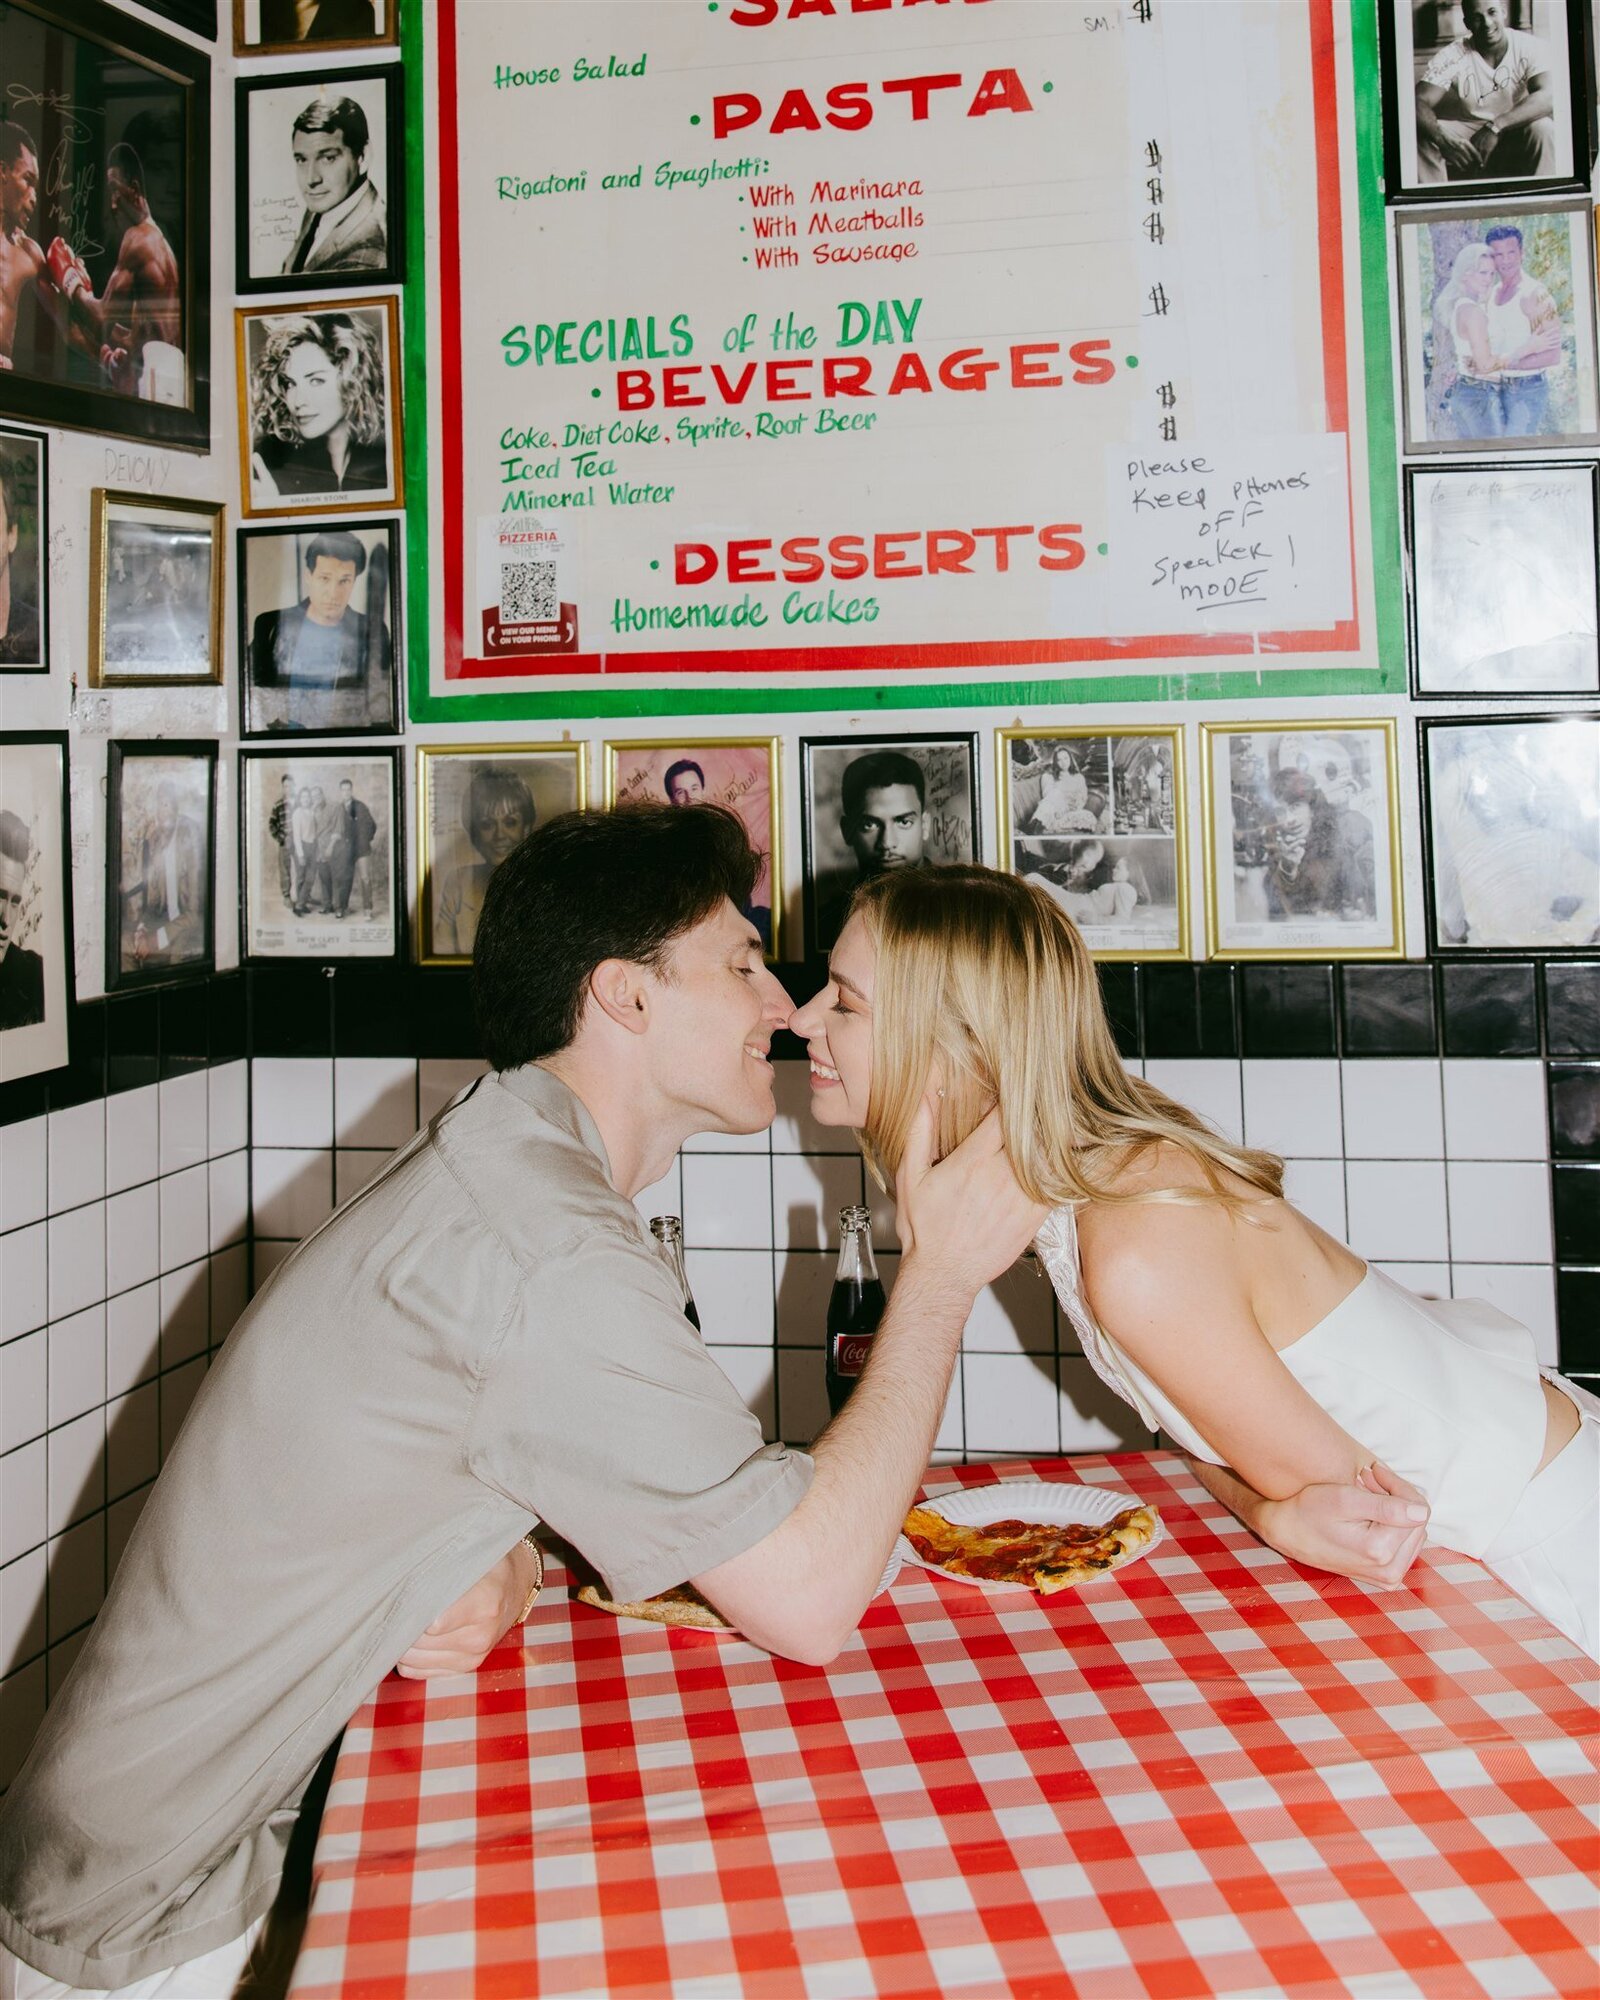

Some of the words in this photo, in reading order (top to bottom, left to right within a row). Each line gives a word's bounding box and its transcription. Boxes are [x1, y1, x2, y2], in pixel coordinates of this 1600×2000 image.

[494, 64, 561, 89] House
[572, 52, 647, 82] Salad
[713, 67, 1033, 139] PASTA
[496, 170, 587, 200] Rigatoni
[601, 164, 643, 190] and
[654, 158, 770, 189] Spaghetti:
[749, 184, 795, 208] With
[810, 179, 923, 203] Marinara
[753, 215, 797, 238] With
[808, 206, 924, 235] Meatballs
[755, 247, 799, 269] With
[813, 242, 918, 265] Sausage
[500, 313, 695, 367] SPECIALS
[722, 313, 758, 353] of
[769, 311, 818, 350] the
[836, 298, 922, 347] DAY
[616, 339, 1116, 412] BEVERAGES
[499, 427, 557, 451] Coke,
[562, 422, 606, 448] Diet
[607, 419, 671, 448] Coke,
[676, 415, 752, 448] Sprite,
[755, 412, 809, 440] Root
[814, 408, 877, 434] Beer
[500, 456, 561, 484] Iced
[571, 451, 617, 478] Tea
[501, 485, 595, 513] Mineral
[608, 481, 675, 506] Water
[499, 532, 557, 543] PIZZERIA
[674, 524, 1086, 585] DESSERTS
[611, 593, 768, 633] Homemade
[781, 589, 880, 624] Cakes
